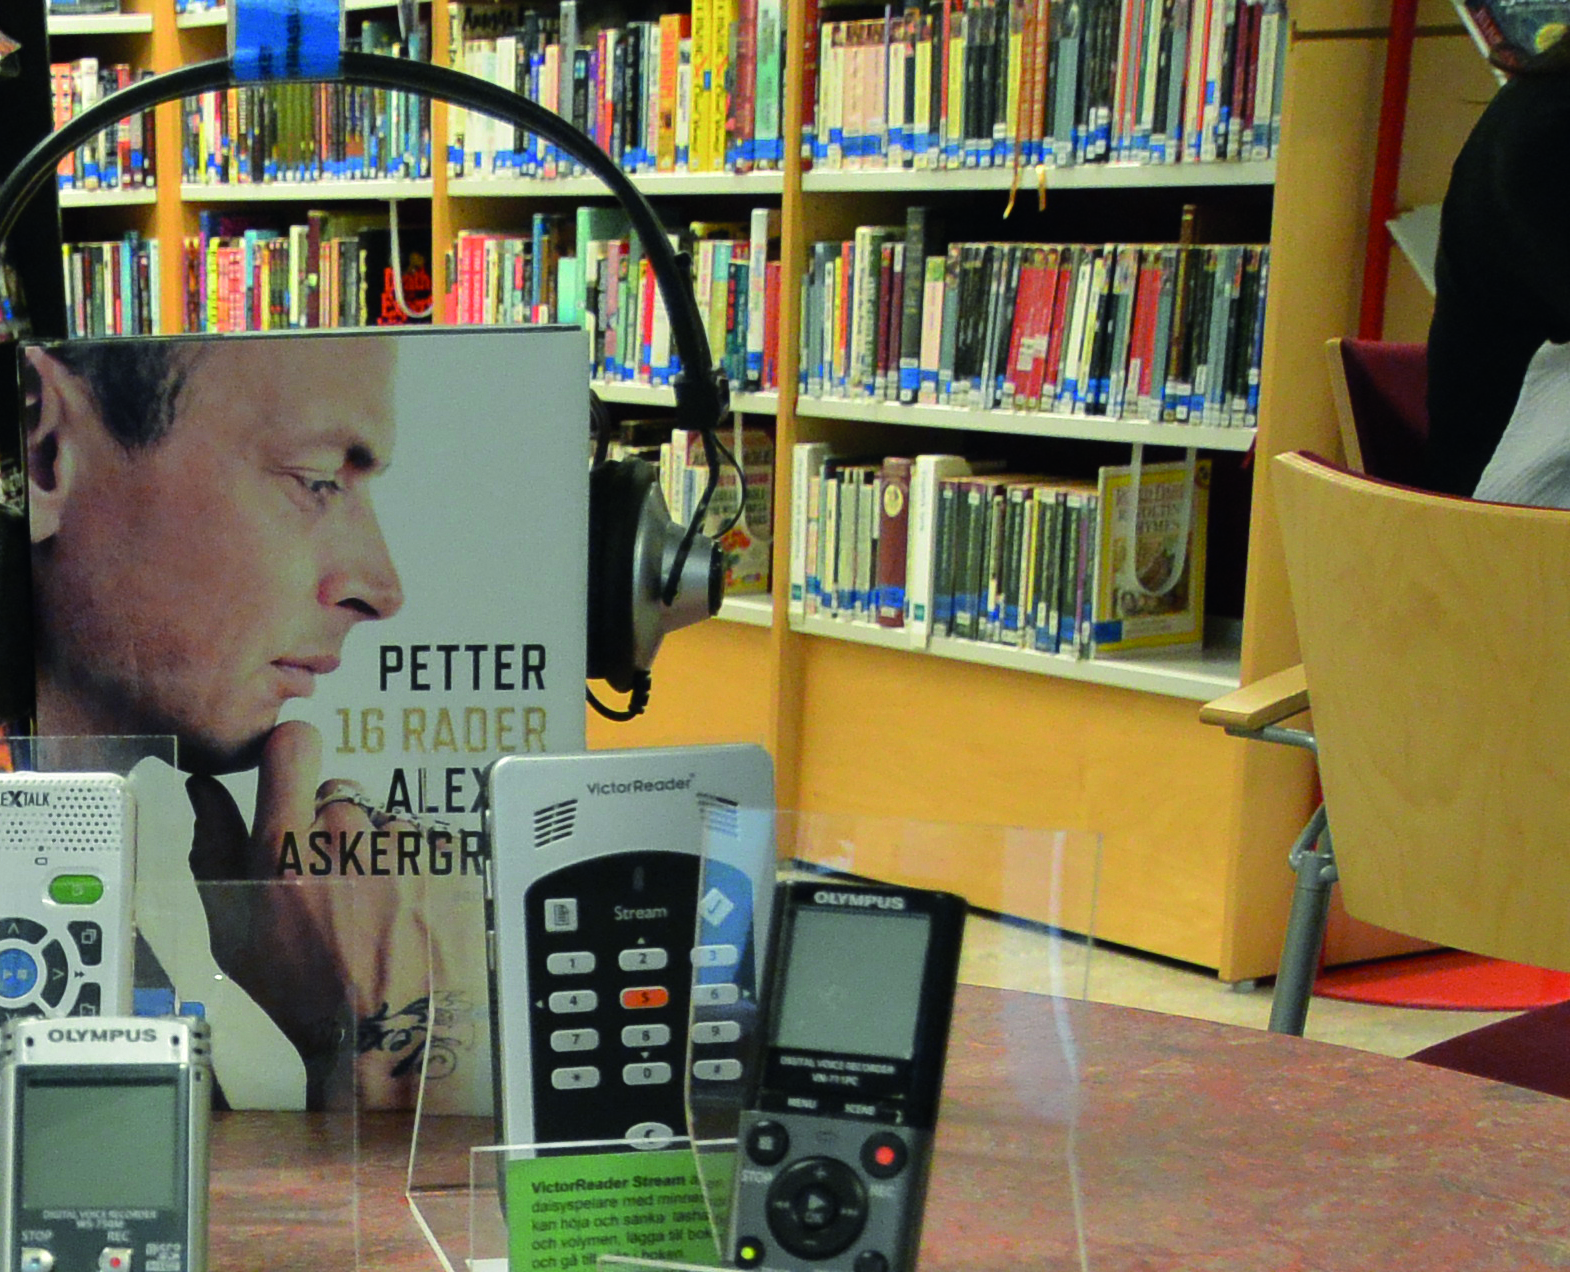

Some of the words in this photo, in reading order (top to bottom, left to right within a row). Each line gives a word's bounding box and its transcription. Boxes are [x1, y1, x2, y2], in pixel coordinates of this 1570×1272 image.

[379, 644, 546, 691] PETTER
[335, 706, 386, 754] 16
[587, 778, 692, 796] VictorReader
[813, 890, 906, 910] OLYMPUS
[614, 905, 668, 921] Stream
[639, 953, 647, 965] 2
[569, 996, 578, 1006] 4
[47, 1028, 158, 1043] OLYMPUS
[531, 1177, 629, 1194] VictorReader
[632, 1175, 686, 1188] Stream
[531, 1220, 557, 1232] kan
[560, 1218, 590, 1231] höja
[593, 1216, 619, 1228] och
[21, 1229, 53, 1242] STOP
[107, 1230, 129, 1242] REC
[531, 1237, 557, 1251] och
[531, 1257, 557, 1269] och
[560, 1253, 578, 1270] gå
[581, 1252, 597, 1265] till
